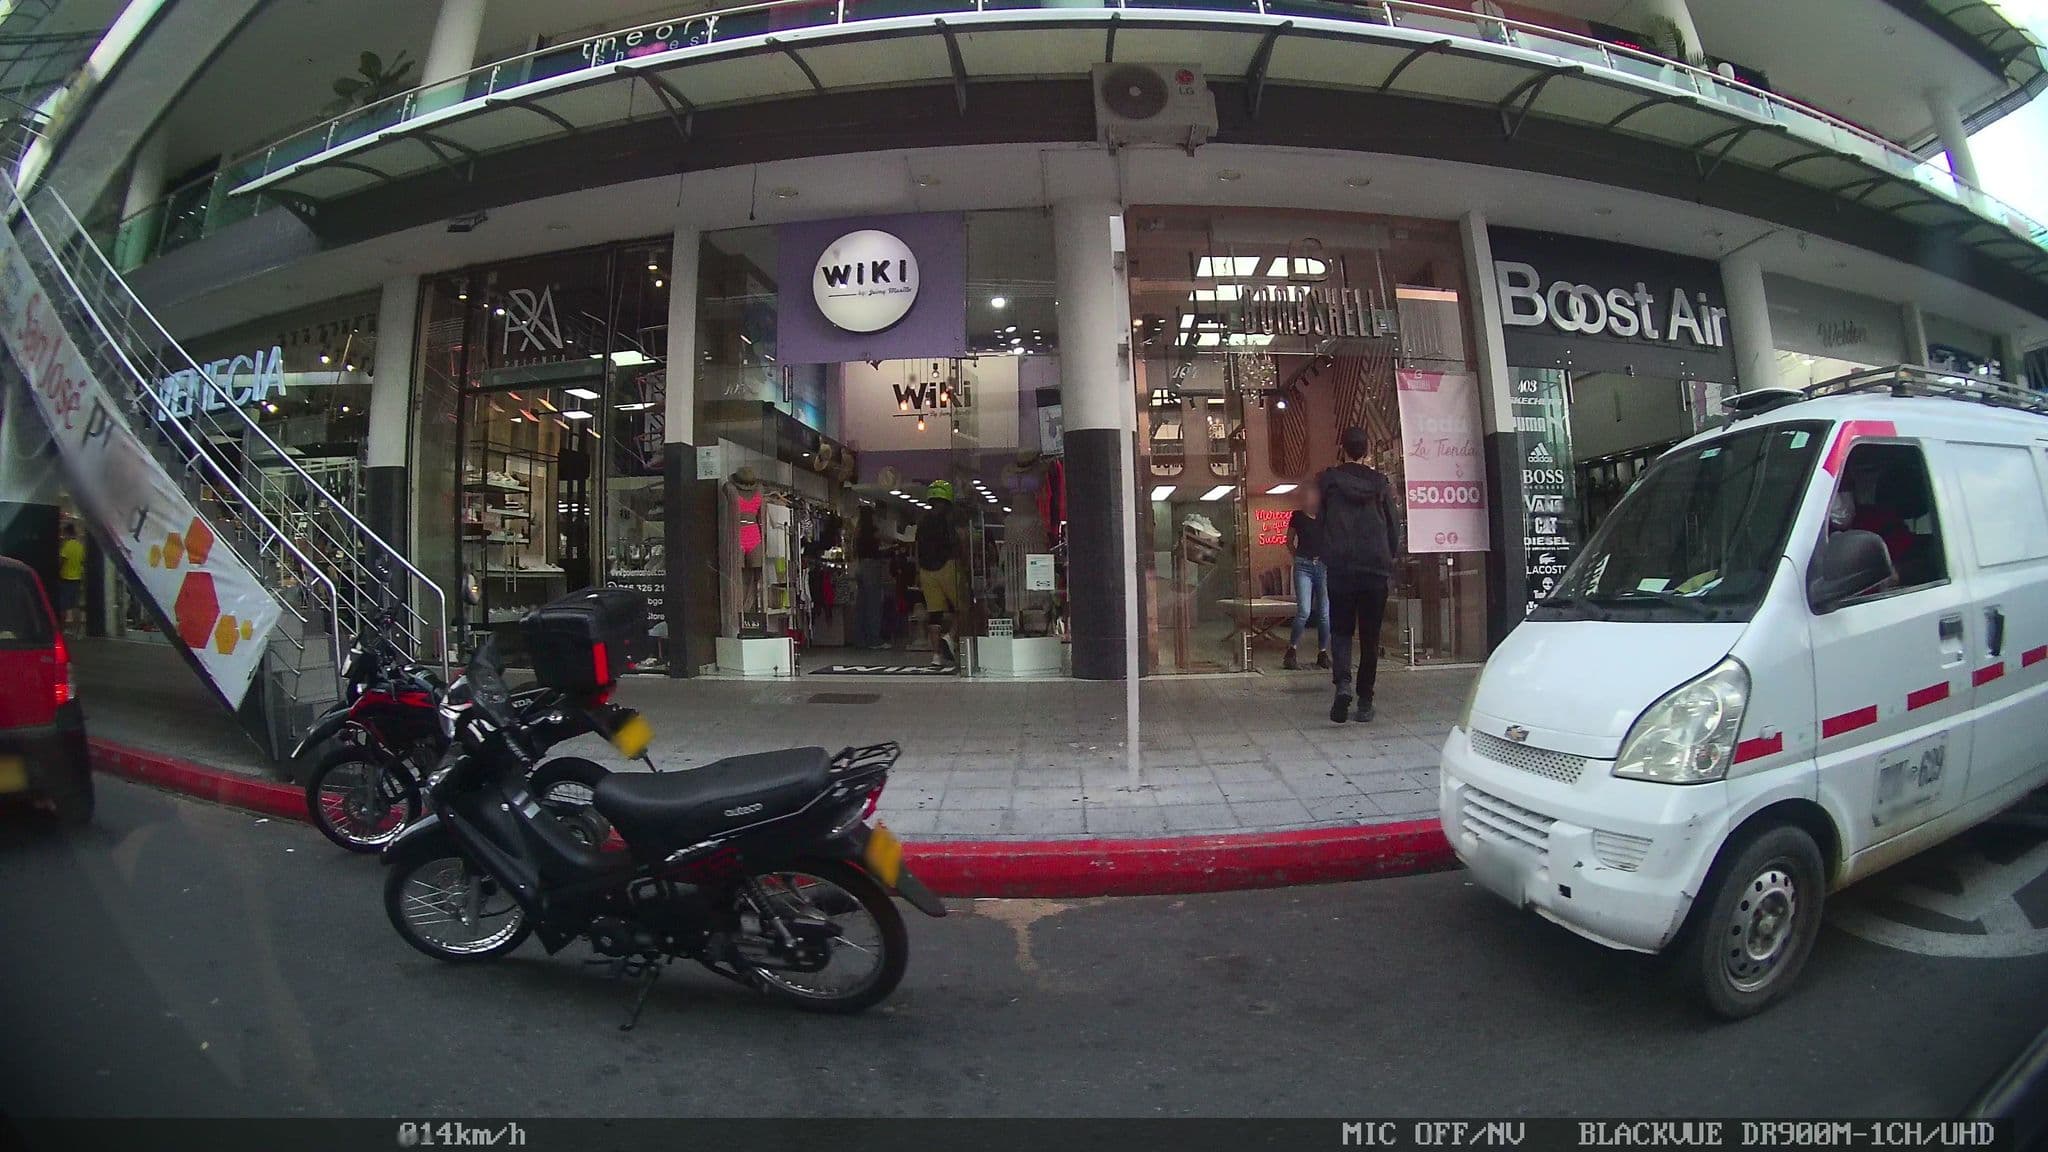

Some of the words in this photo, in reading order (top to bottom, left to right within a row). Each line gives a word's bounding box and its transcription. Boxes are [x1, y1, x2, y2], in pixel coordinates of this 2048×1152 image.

[596, 35, 700, 66] shes
[1242, 284, 1384, 338] BOMBSHELL
[1494, 260, 1659, 340] Boost
[1667, 287, 1727, 347] Air
[1408, 437, 1428, 460] La
[1433, 437, 1481, 458] Tienda
[1528, 455, 1553, 463] adidas
[1522, 469, 1564, 485] BOSS
[1408, 485, 1480, 504] $50.000
[1534, 516, 1558, 534] CAT
[1523, 536, 1570, 546] DIESEL
